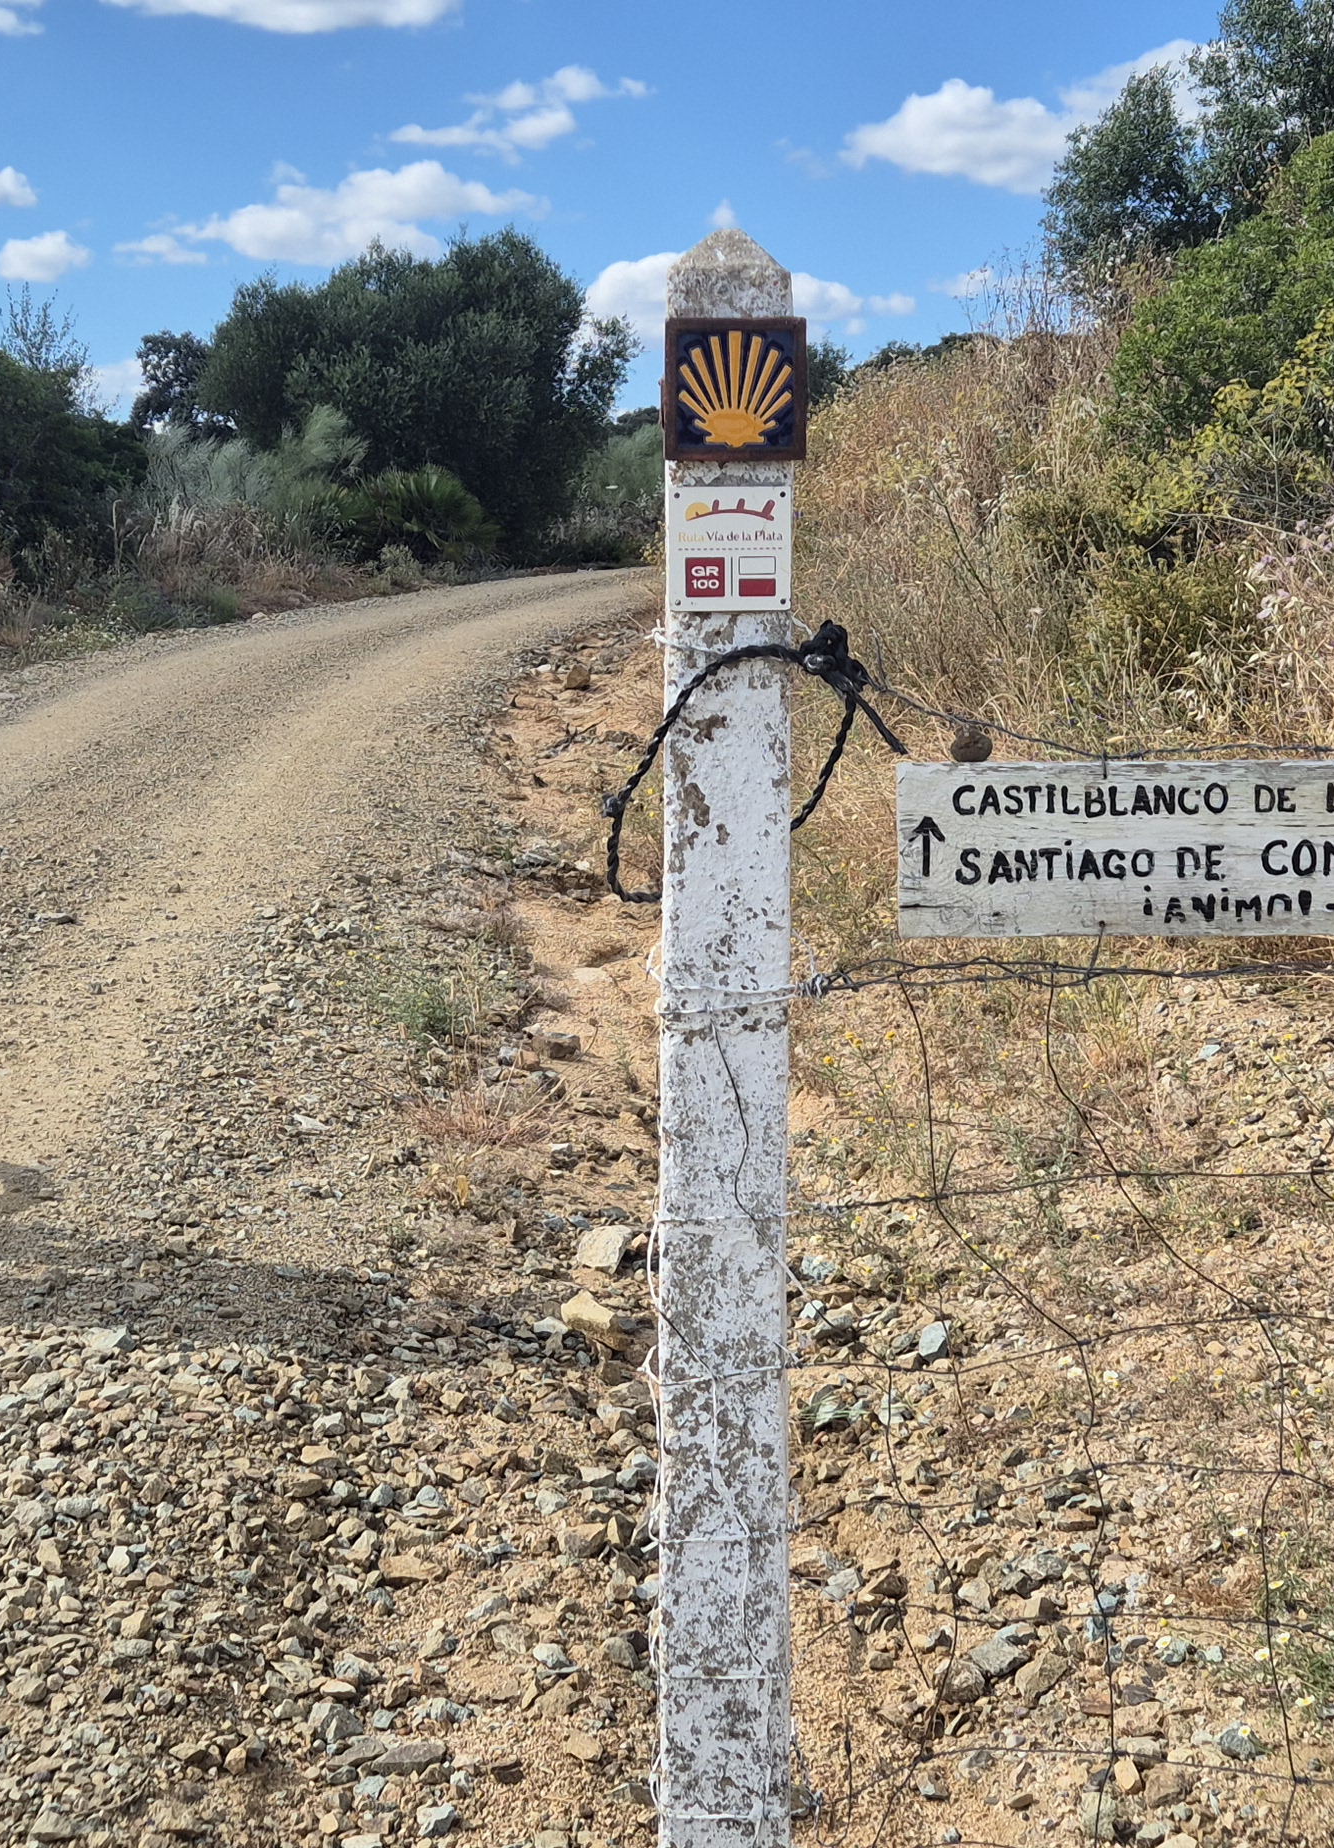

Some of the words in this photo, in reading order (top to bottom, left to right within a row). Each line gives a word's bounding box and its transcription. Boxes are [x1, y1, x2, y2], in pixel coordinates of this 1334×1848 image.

[678, 531, 706, 543] Ruta
[706, 530, 724, 541] Vía
[727, 531, 740, 541] de
[742, 530, 752, 541] la
[754, 529, 783, 541] Plata
[691, 566, 719, 577] GR
[691, 579, 720, 590] 100
[952, 782, 1229, 818] CASTILBLANCO
[1254, 784, 1296, 813] DE
[1176, 844, 1227, 882] DE
